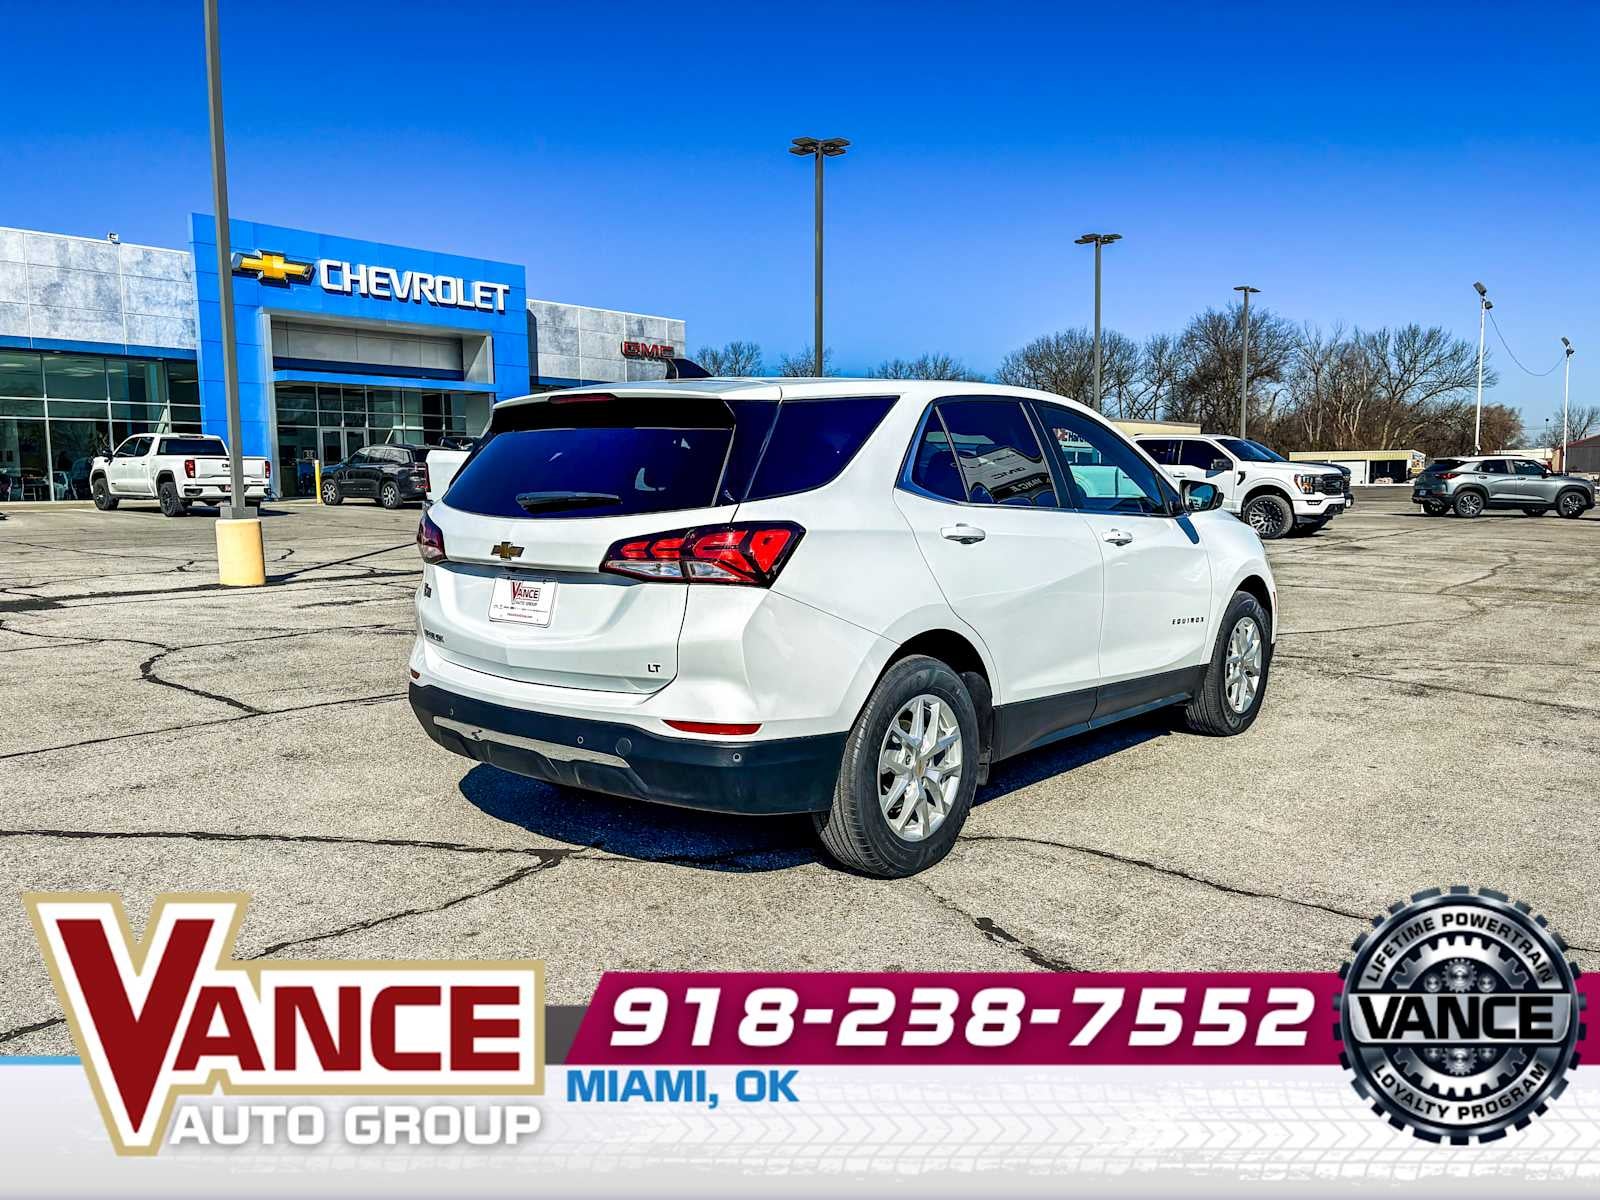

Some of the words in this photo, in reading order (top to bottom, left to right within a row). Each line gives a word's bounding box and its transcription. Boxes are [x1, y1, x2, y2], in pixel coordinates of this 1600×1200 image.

[319, 258, 510, 312] CHEVROLET
[621, 341, 674, 361] GMC
[511, 581, 539, 600] VANCE
[647, 663, 661, 673] LT
